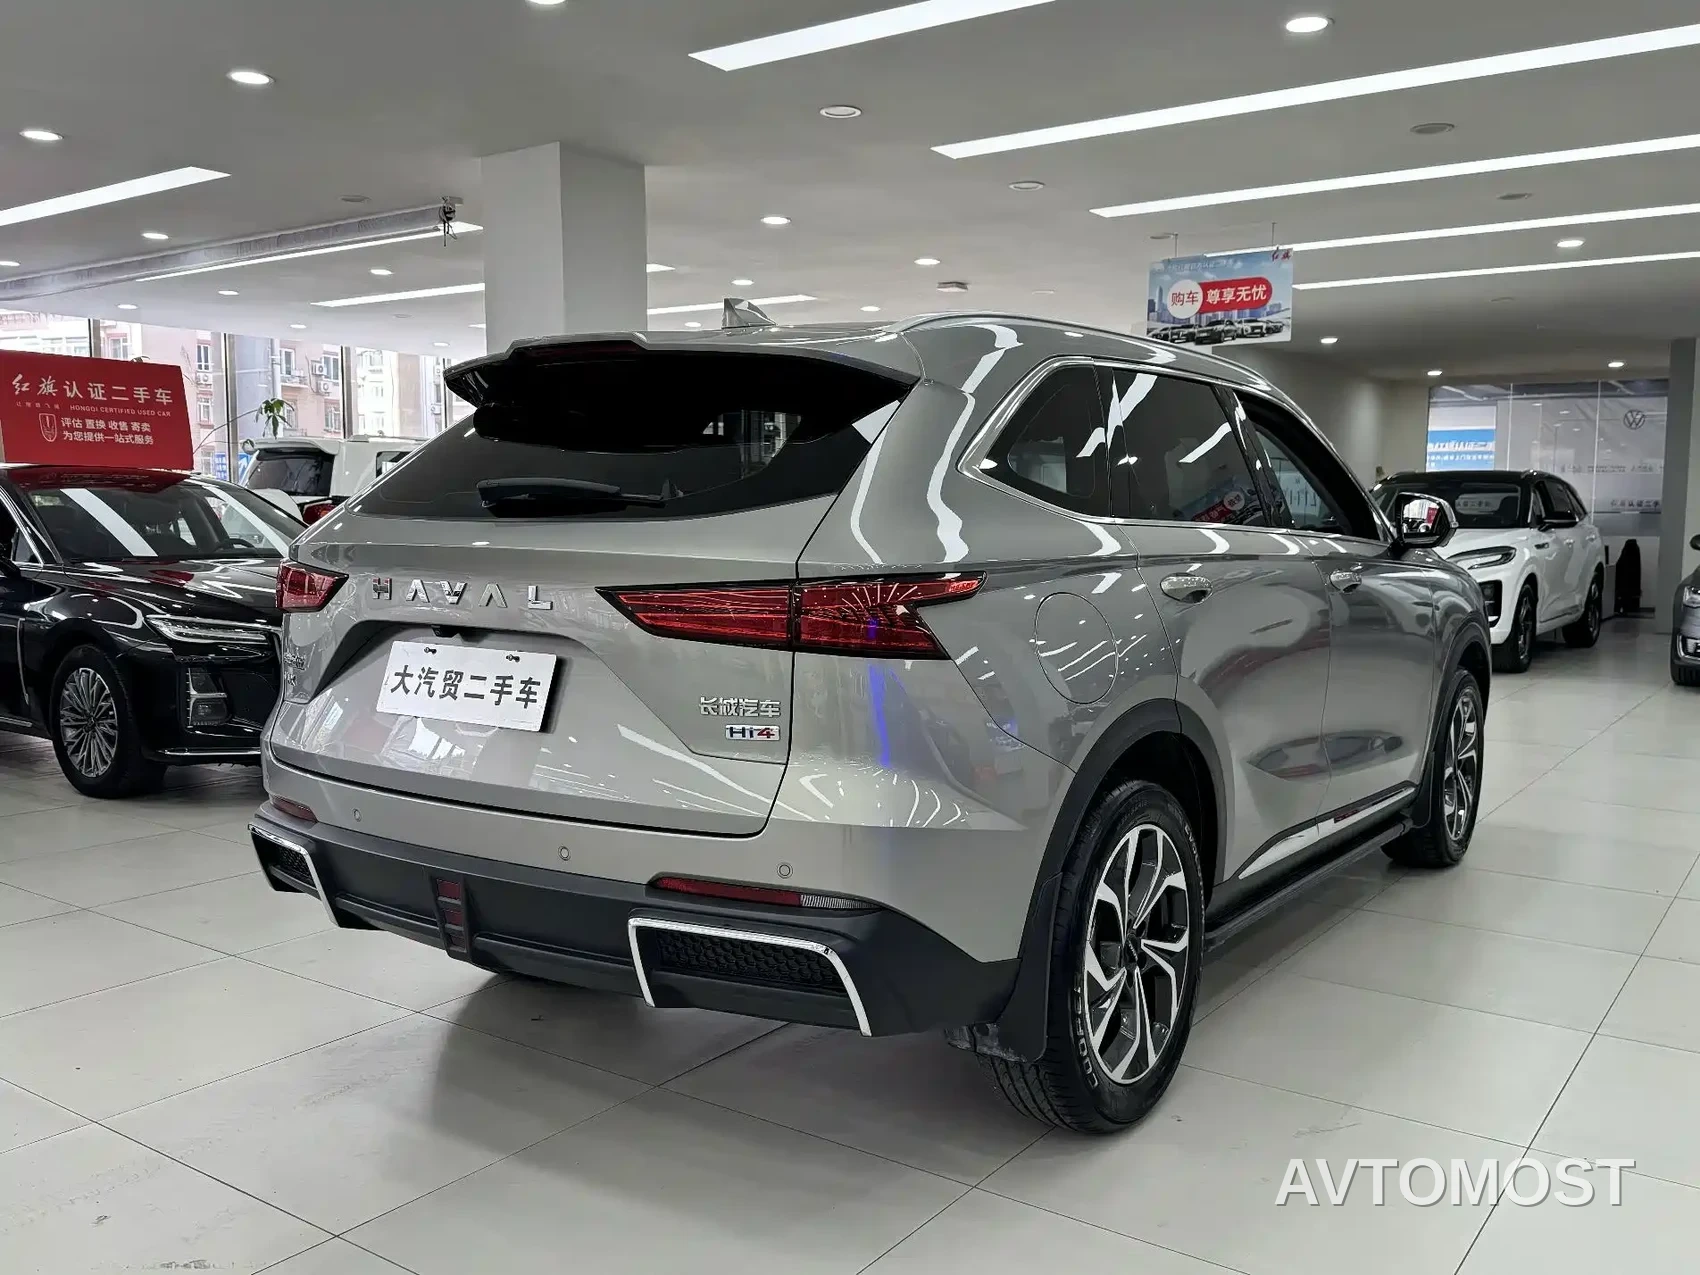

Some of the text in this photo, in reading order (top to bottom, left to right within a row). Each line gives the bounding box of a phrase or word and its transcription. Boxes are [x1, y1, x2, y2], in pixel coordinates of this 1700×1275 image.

[1171, 284, 1267, 306] 购车 尊享无忧
[12, 374, 173, 405] 红旗认证二手车
[70, 404, 98, 412] HONGQI
[100, 406, 136, 415] CERTIFIED
[60, 417, 83, 428] 评估
[85, 419, 106, 430] 置换
[130, 421, 151, 432] 寄卖
[62, 431, 154, 445] 为您提供一站式服务
[373, 578, 553, 610] HAVAL
[390, 665, 541, 709] 大汽贸二手车
[699, 697, 780, 718] 长城汽车
[729, 727, 775, 738] Hi4
